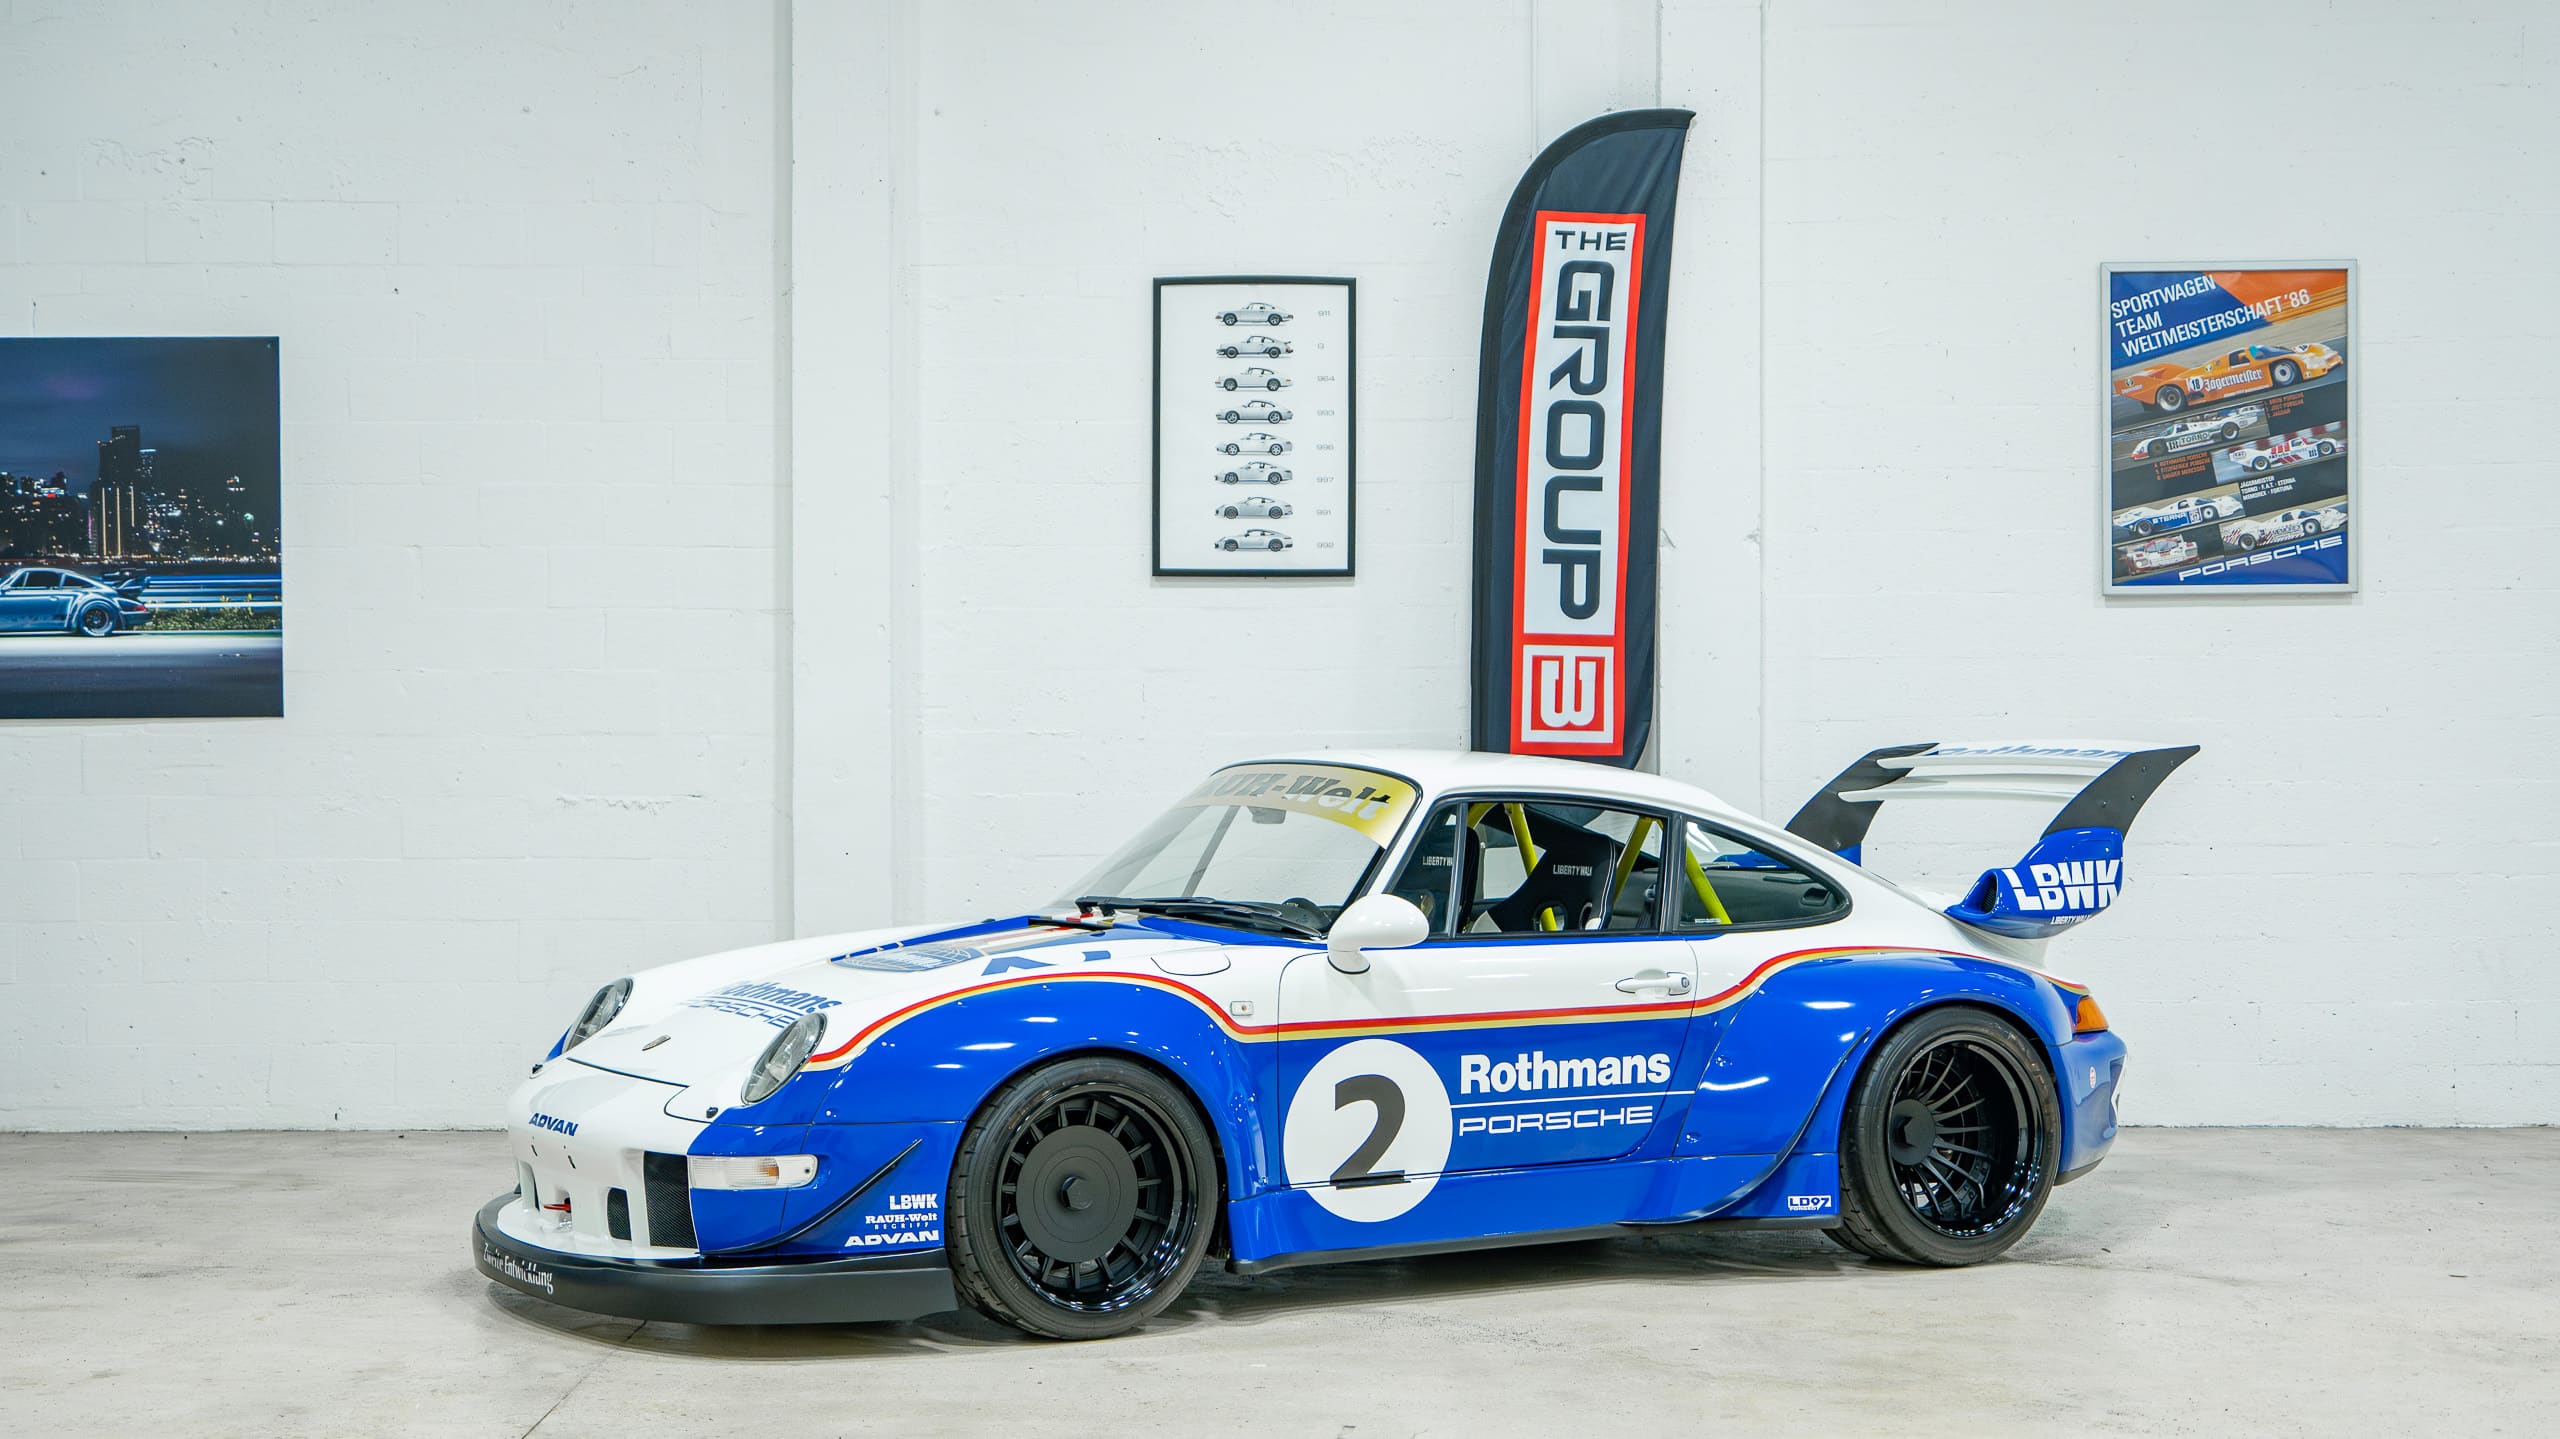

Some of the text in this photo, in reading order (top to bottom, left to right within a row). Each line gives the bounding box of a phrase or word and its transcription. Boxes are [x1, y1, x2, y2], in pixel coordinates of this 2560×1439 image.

[1554, 230, 1628, 252] THE
[2111, 274, 2217, 319] SPORTWAGEN
[2115, 311, 2163, 338] TEAM
[2121, 297, 2283, 358] WELTMEISTERSCHAFT
[1542, 260, 1616, 620] GROUP
[2181, 432, 2208, 443] TORNO
[2178, 535, 2343, 582] PORSCHE
[2001, 859, 2120, 911] LBWK
[1460, 1051, 1671, 1095] Rothmans
[528, 1112, 579, 1137] ADVAN
[1329, 1073, 1411, 1191] 2
[1459, 1105, 1654, 1137] PORSCHE
[889, 1193, 939, 1210] LBWK
[865, 1212, 938, 1224] RAUH-Welt
[874, 1221, 929, 1230] BEGRIFF
[844, 1230, 940, 1247] ADVAN
[483, 1242, 554, 1295] Zweite Entwicklung
